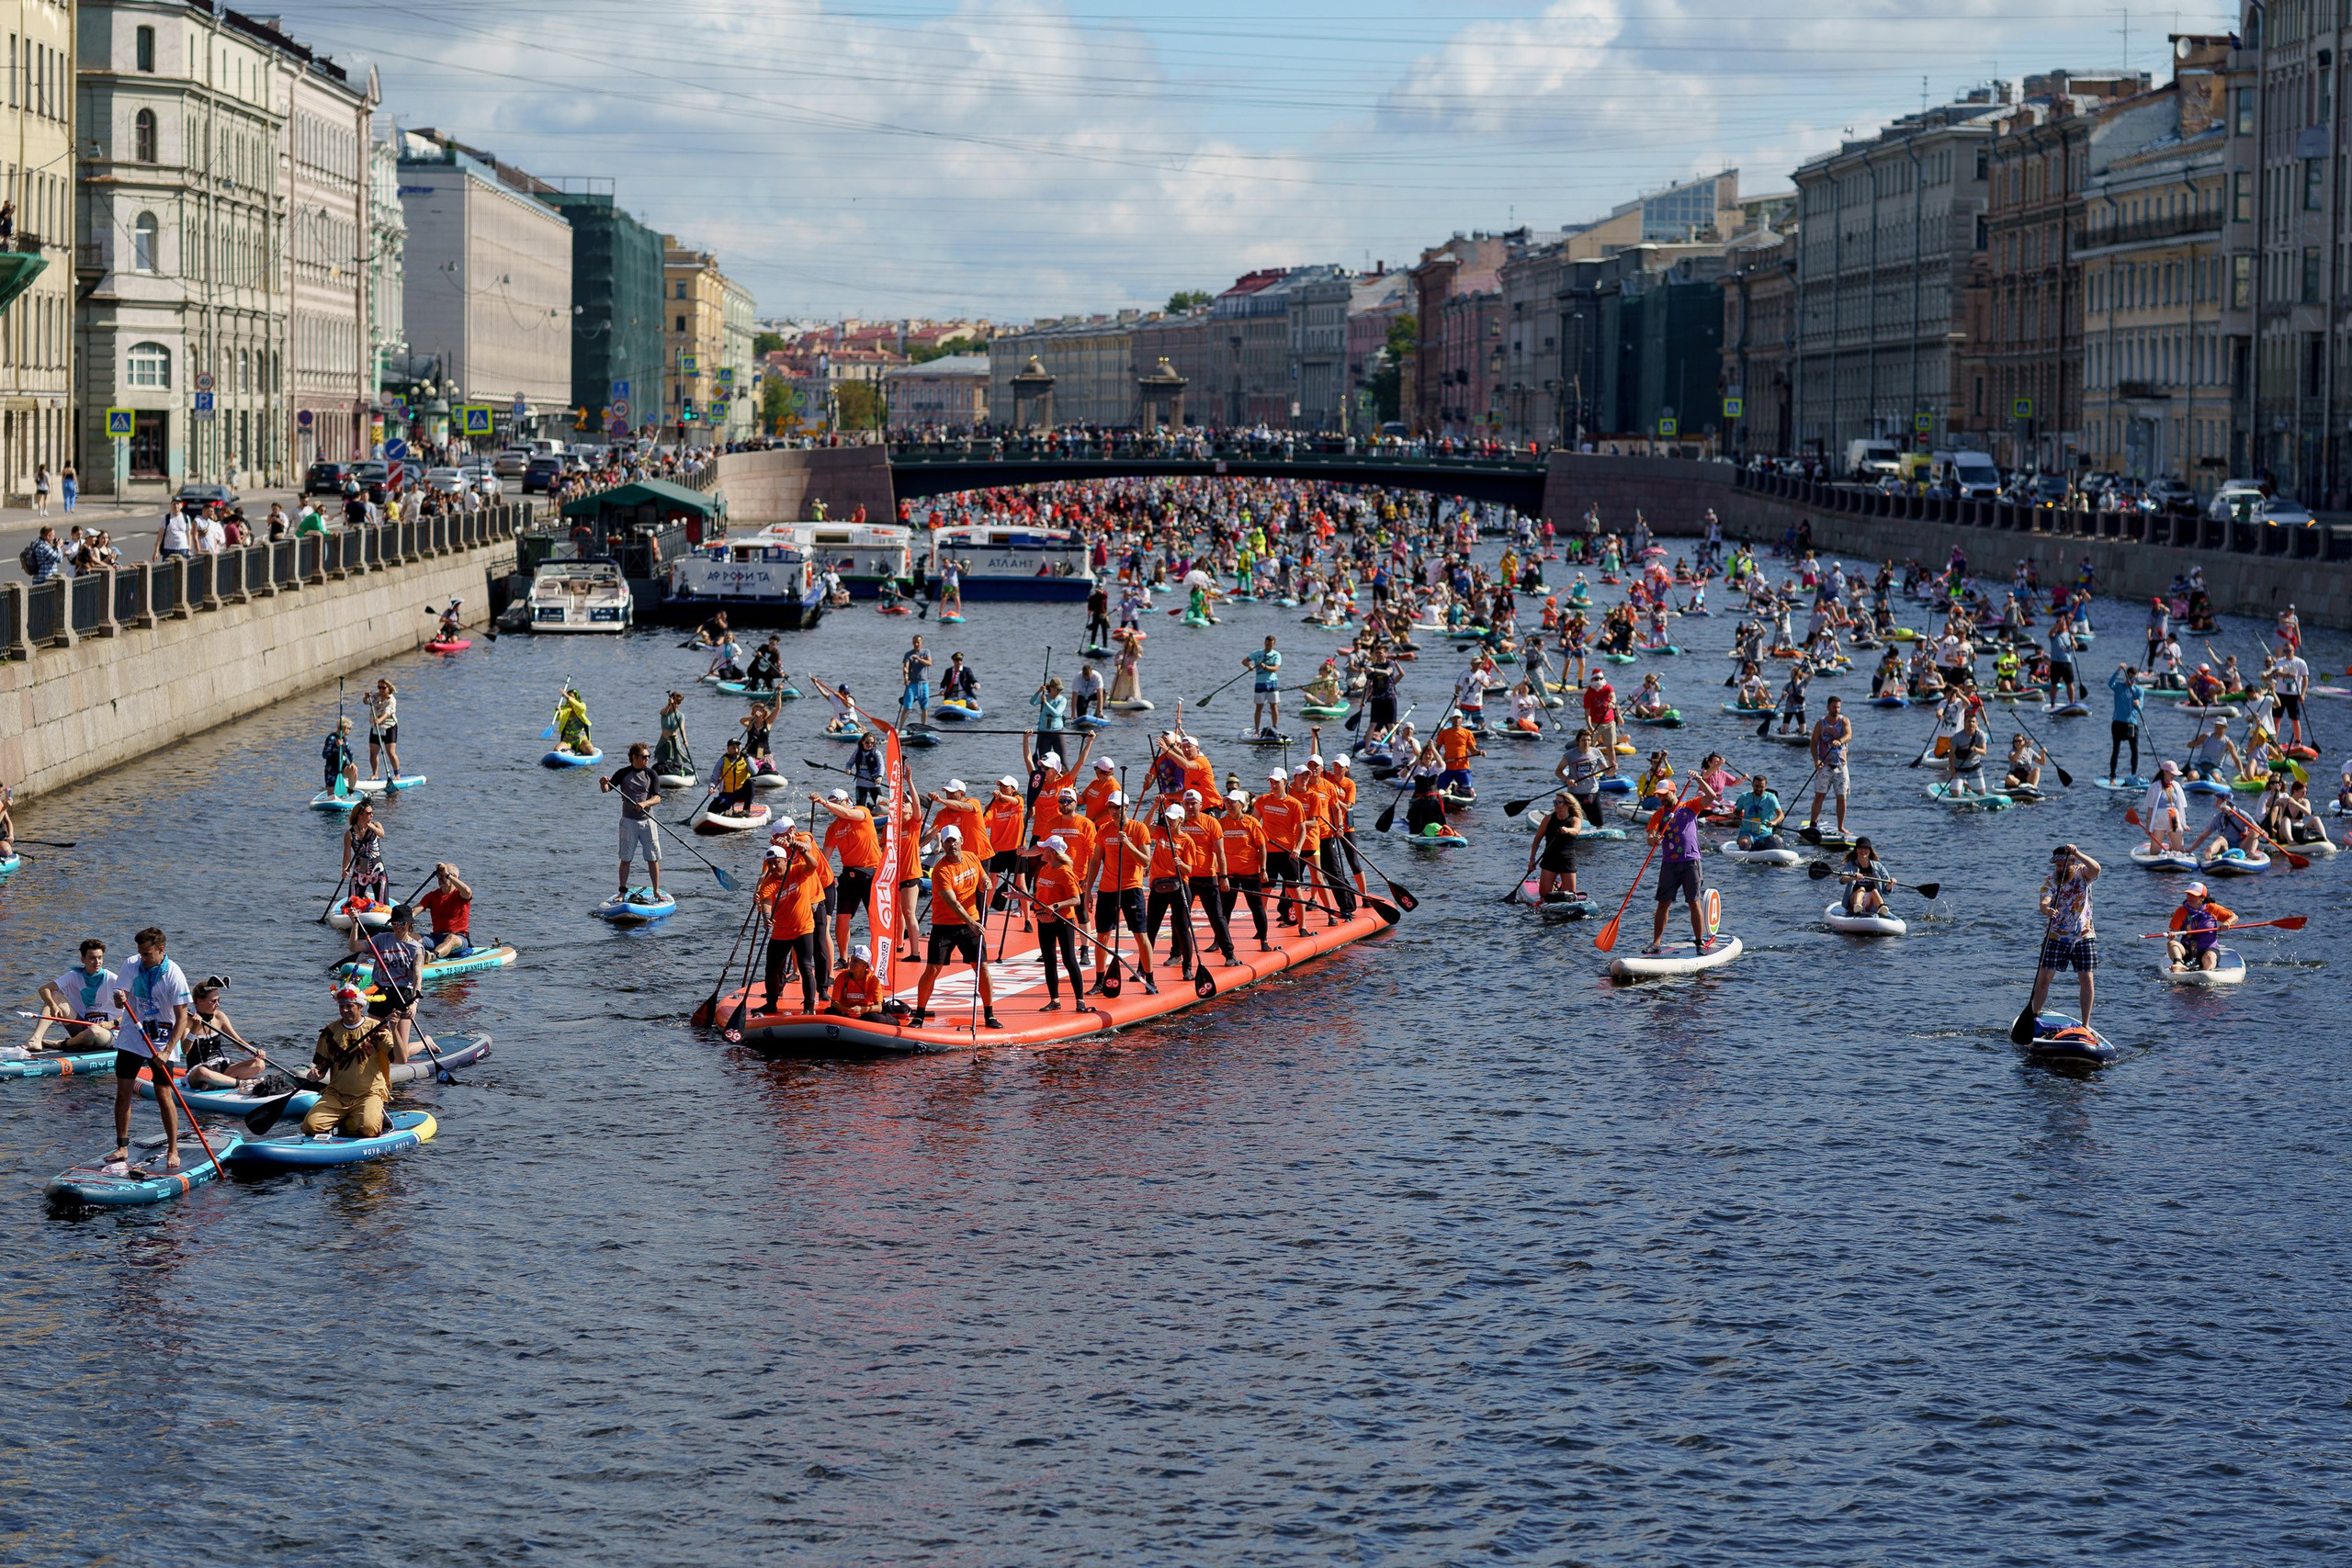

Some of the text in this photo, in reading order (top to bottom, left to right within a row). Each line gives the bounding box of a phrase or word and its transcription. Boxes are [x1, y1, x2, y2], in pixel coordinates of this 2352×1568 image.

[199, 378, 210, 386] 40
[988, 558, 1035, 569] АТЛАНТ
[464, 963, 483, 972] WINNER
